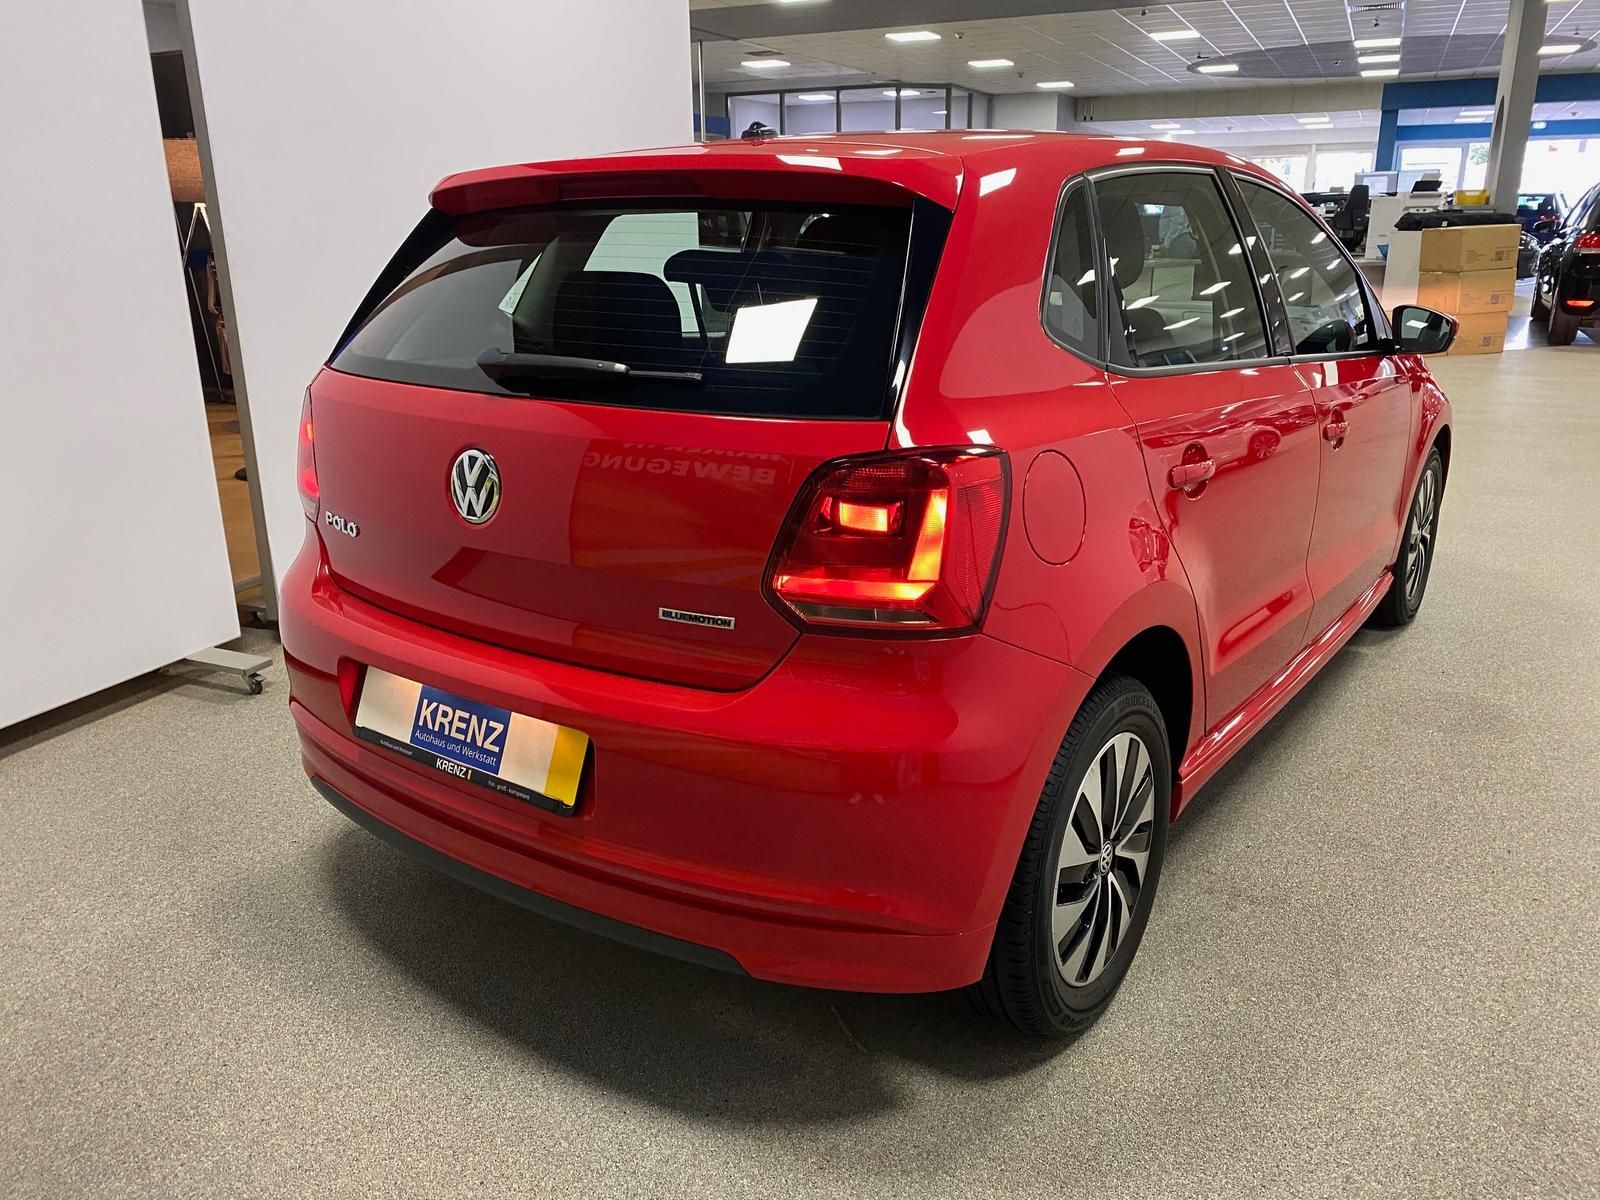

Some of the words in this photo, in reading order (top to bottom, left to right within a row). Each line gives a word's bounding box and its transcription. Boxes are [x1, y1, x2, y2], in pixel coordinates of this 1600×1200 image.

[452, 449, 500, 523] VW
[325, 510, 359, 537] POLO
[661, 608, 732, 628] BLUEMOTION
[418, 698, 504, 753] KRENZ
[415, 729, 446, 748] Autohaus
[447, 742, 461, 753] und
[462, 744, 497, 766] Werkstatt
[436, 758, 466, 778] KRENZ
